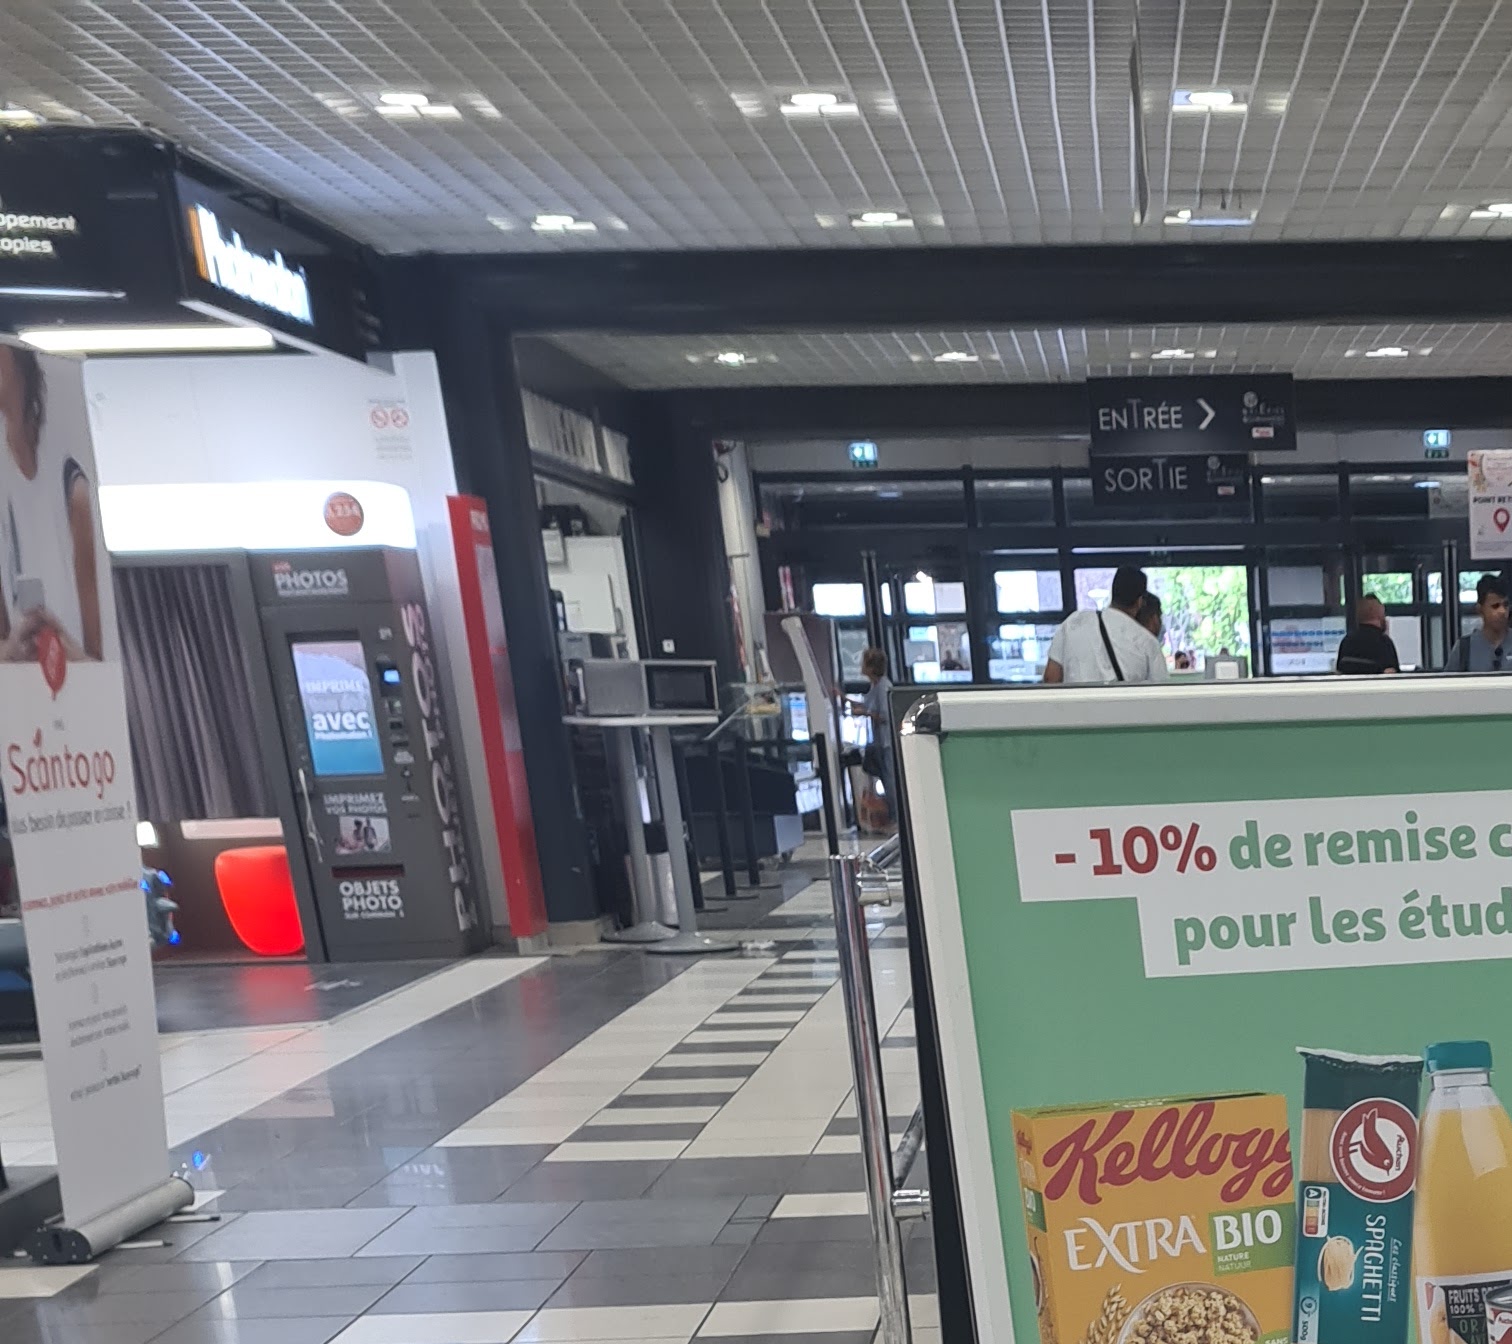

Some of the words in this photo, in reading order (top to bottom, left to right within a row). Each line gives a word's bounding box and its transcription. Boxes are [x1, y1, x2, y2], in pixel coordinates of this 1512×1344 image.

[1099, 398, 1183, 430] ENTRÉE
[1105, 458, 1188, 492] SORTIE
[312, 711, 371, 731] avec
[1229, 820, 1292, 869] de
[1304, 810, 1478, 866] remise
[339, 880, 400, 896] OBJETS
[342, 895, 402, 910] PHOTO
[1174, 911, 1296, 965] pour
[1308, 896, 1386, 944] les
[1064, 1215, 1207, 1273] EXTRA
[1213, 1209, 1282, 1250] BIO
[1217, 1252, 1249, 1263] NATURE
[1361, 1214, 1387, 1322] SPAGHETTI
[1448, 1286, 1480, 1304] FRUITS
[1450, 1304, 1475, 1315] 100%
